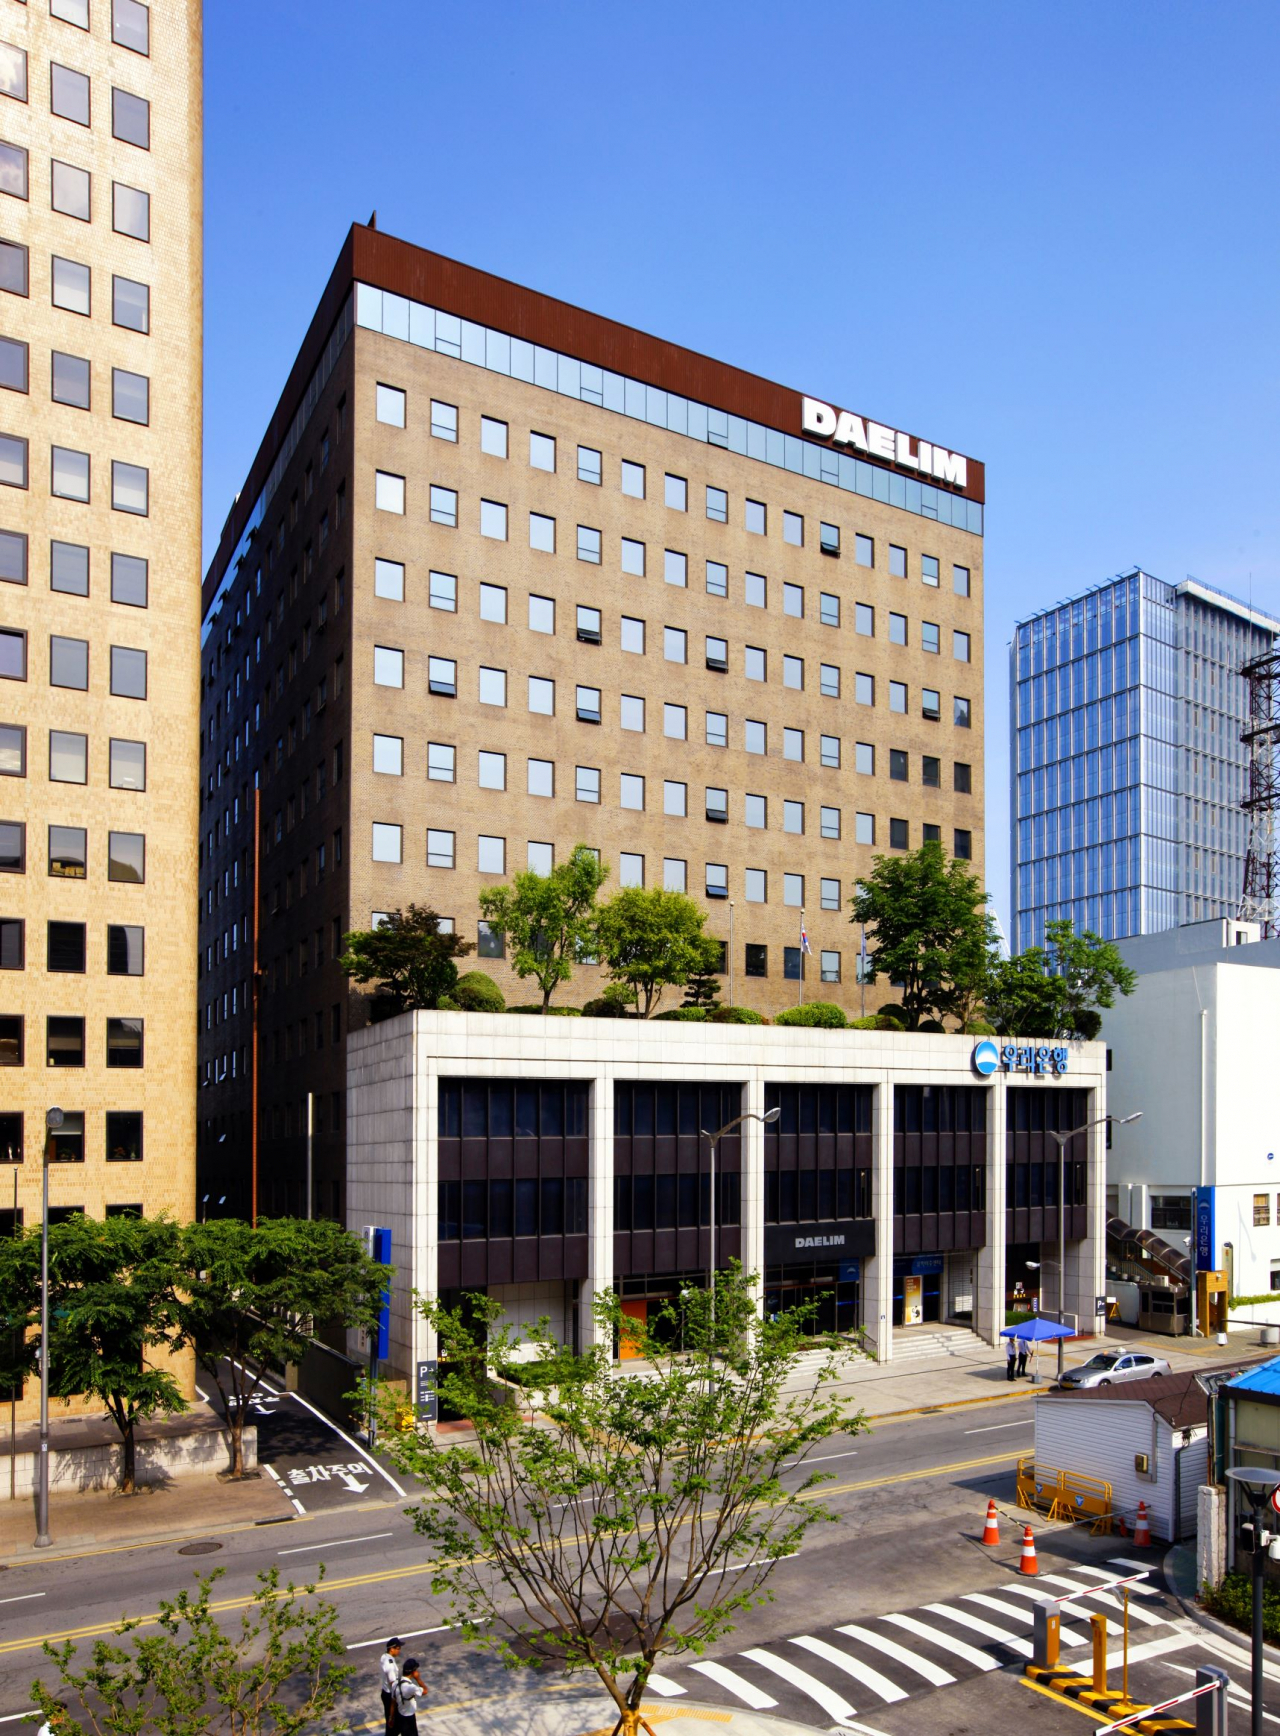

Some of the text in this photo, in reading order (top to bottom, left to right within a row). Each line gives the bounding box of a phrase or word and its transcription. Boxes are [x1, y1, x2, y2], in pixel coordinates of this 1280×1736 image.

[802, 396, 967, 488] DAELIM
[1003, 1044, 1069, 1074] 우리은행
[795, 1235, 845, 1248] DAELIM
[1200, 1214, 1209, 1257] 우리은행
[420, 1366, 428, 1378] P
[287, 1462, 374, 1485] 출차주의
